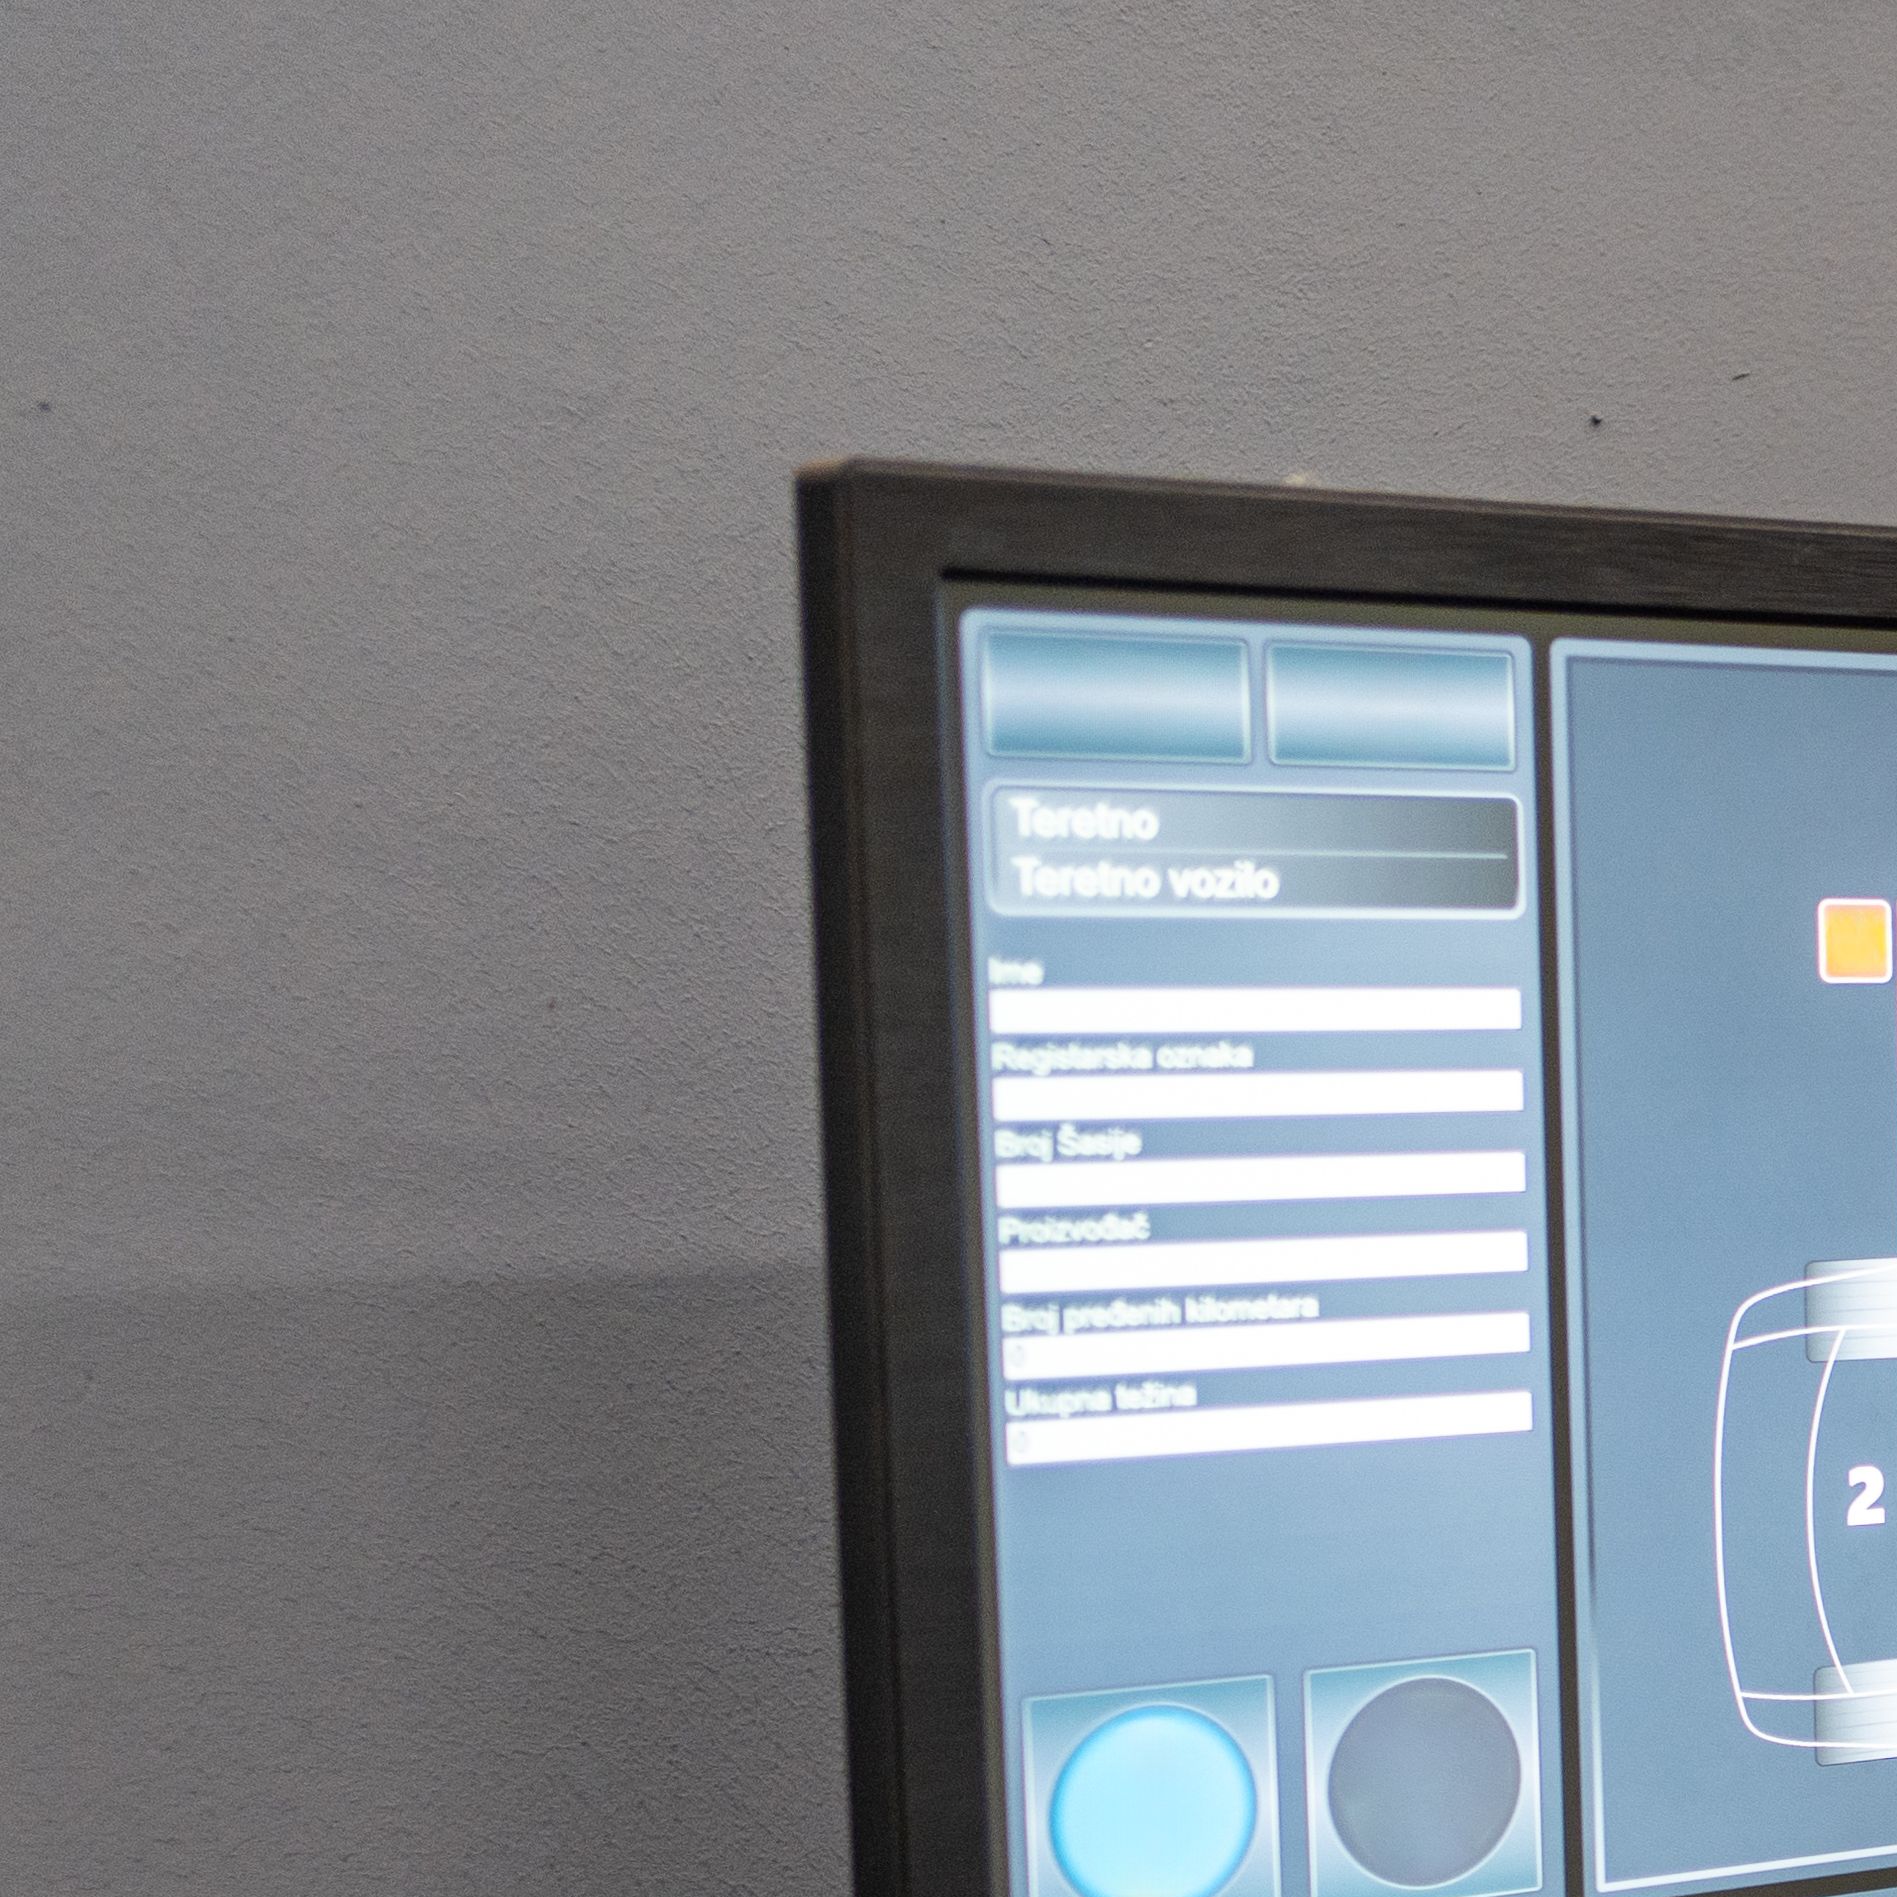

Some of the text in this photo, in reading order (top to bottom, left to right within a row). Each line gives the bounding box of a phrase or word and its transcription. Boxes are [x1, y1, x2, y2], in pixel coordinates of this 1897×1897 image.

[1009, 797, 1159, 841] Teretno
[1011, 856, 1281, 899] Teretno vozilo
[1846, 1466, 1886, 1527] 2
